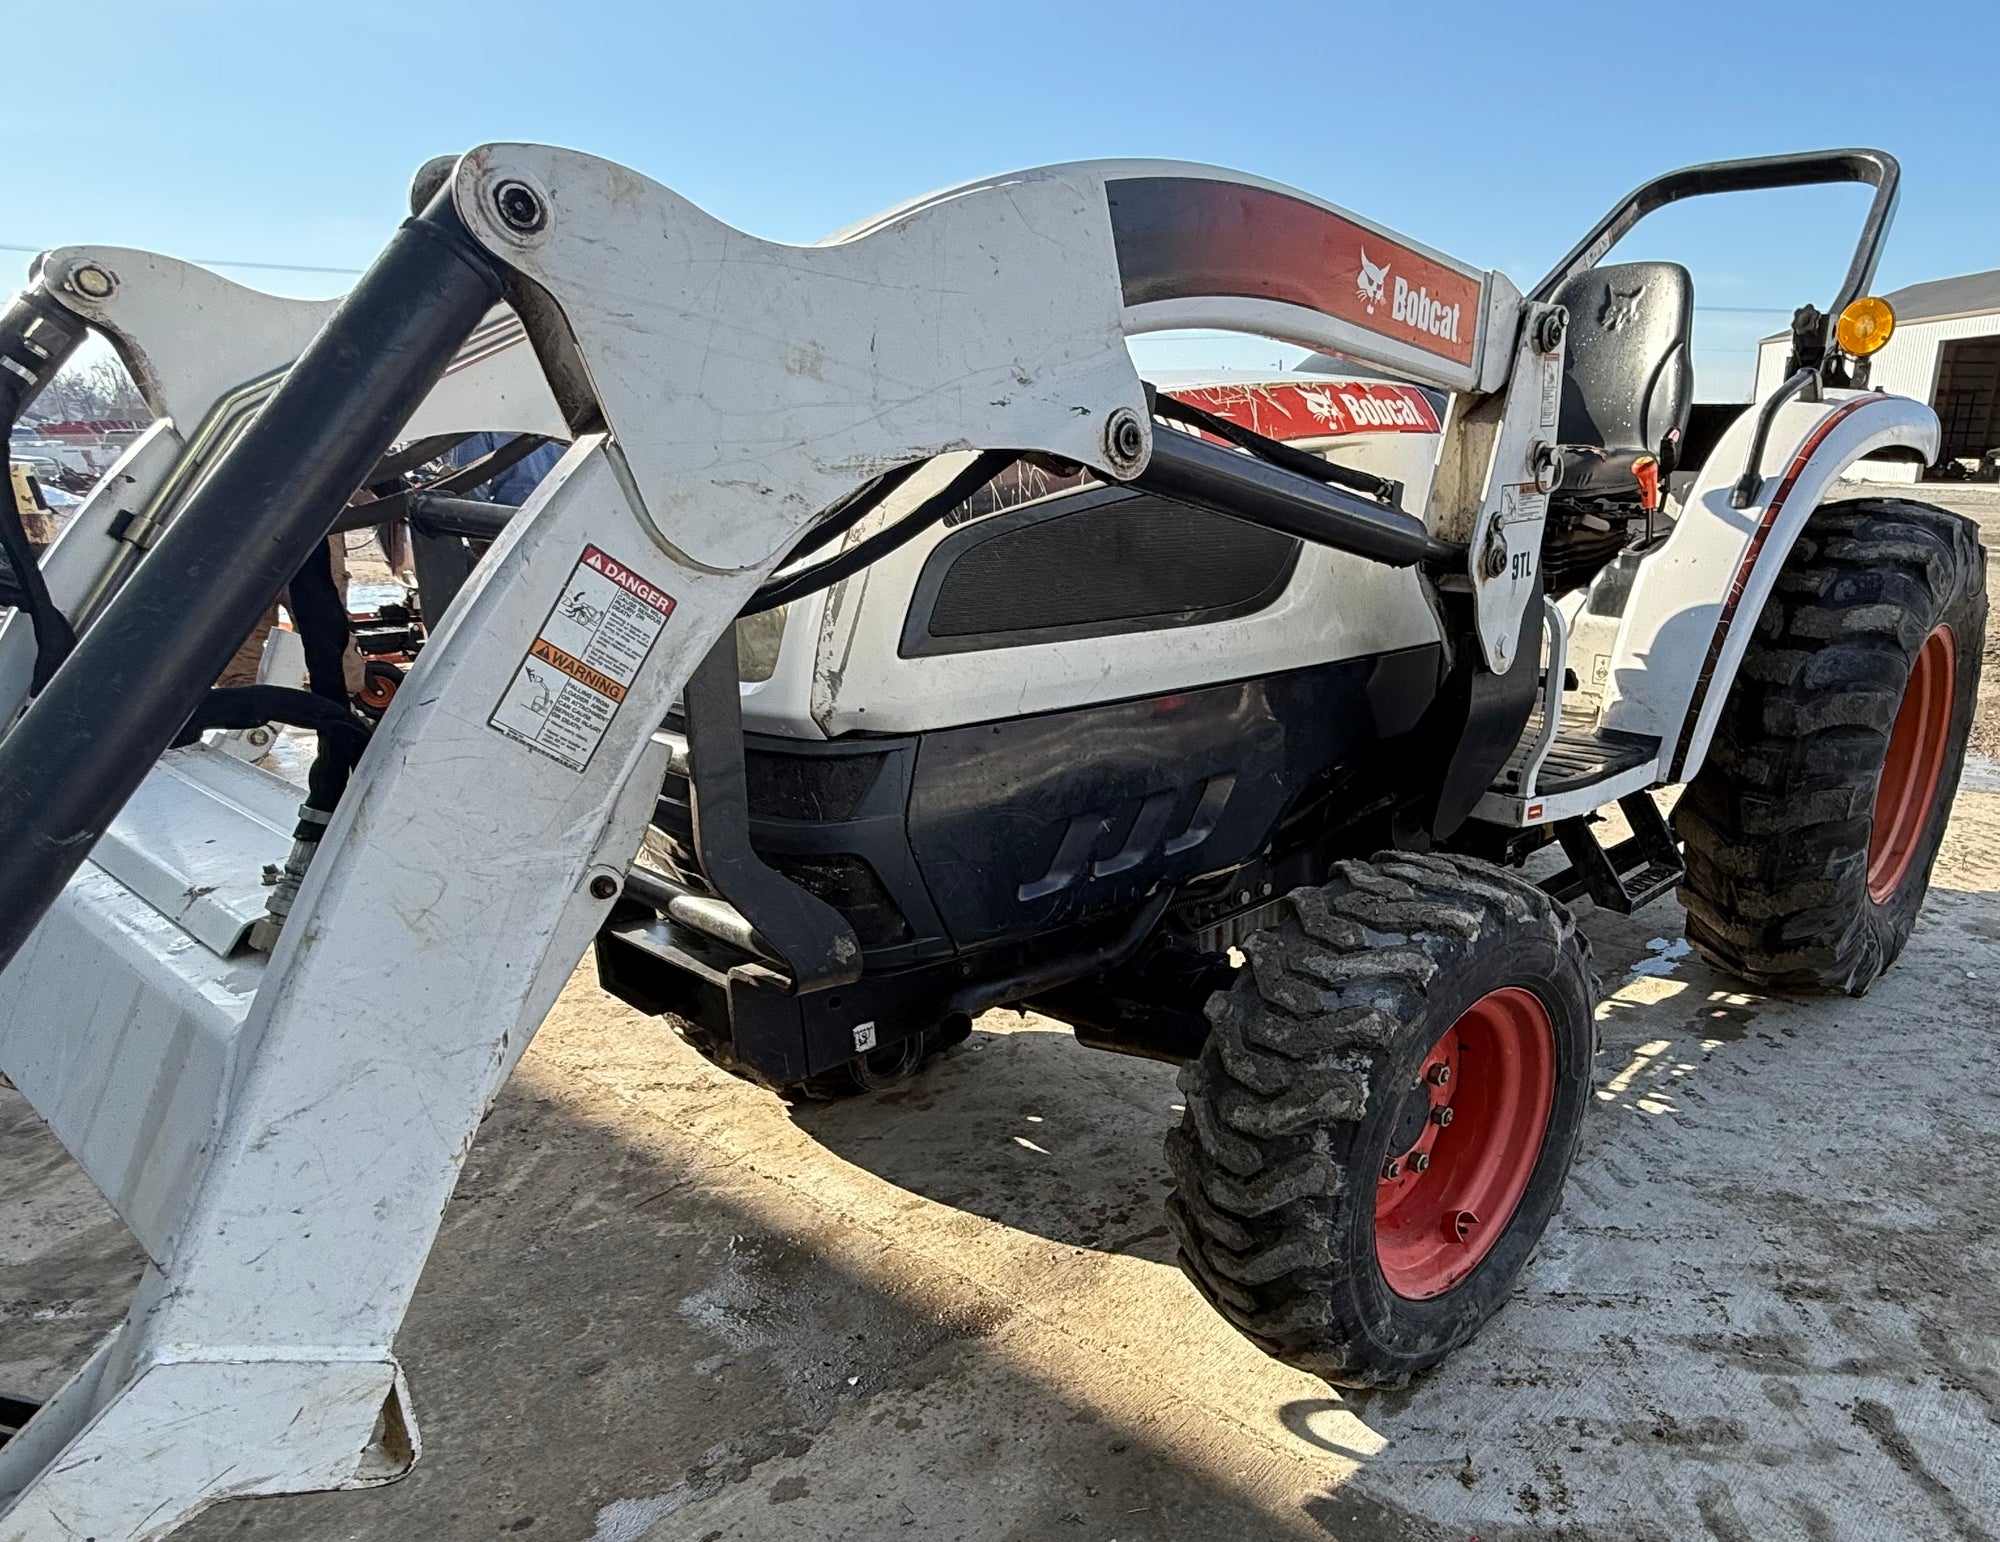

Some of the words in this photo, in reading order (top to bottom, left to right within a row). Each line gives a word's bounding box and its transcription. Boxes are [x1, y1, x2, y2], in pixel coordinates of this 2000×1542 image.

[1392, 275, 1460, 343] Bobcat
[1338, 393, 1424, 425] Bobcat
[1511, 550, 1531, 581] 9TL
[603, 561, 670, 612] DANGER
[611, 603, 631, 619] DEATH
[614, 598, 636, 615] INJURY
[635, 612, 645, 621] OR
[616, 593, 637, 610] CAUSE
[636, 606, 662, 625] SERIOUS
[549, 650, 622, 699] WARNING
[557, 699, 572, 710] CAN
[570, 706, 592, 722] CAUSE
[560, 693, 571, 702] OR
[570, 698, 610, 724] ATTACHMENT
[563, 687, 589, 705] LOADER
[589, 701, 608, 715] ARMS
[566, 681, 593, 699] FALLING
[591, 695, 610, 709] FROM
[550, 710, 561, 720] OR
[560, 716, 581, 731] DEATH
[553, 704, 581, 723] SERIOUS
[580, 719, 602, 735] INJURY
